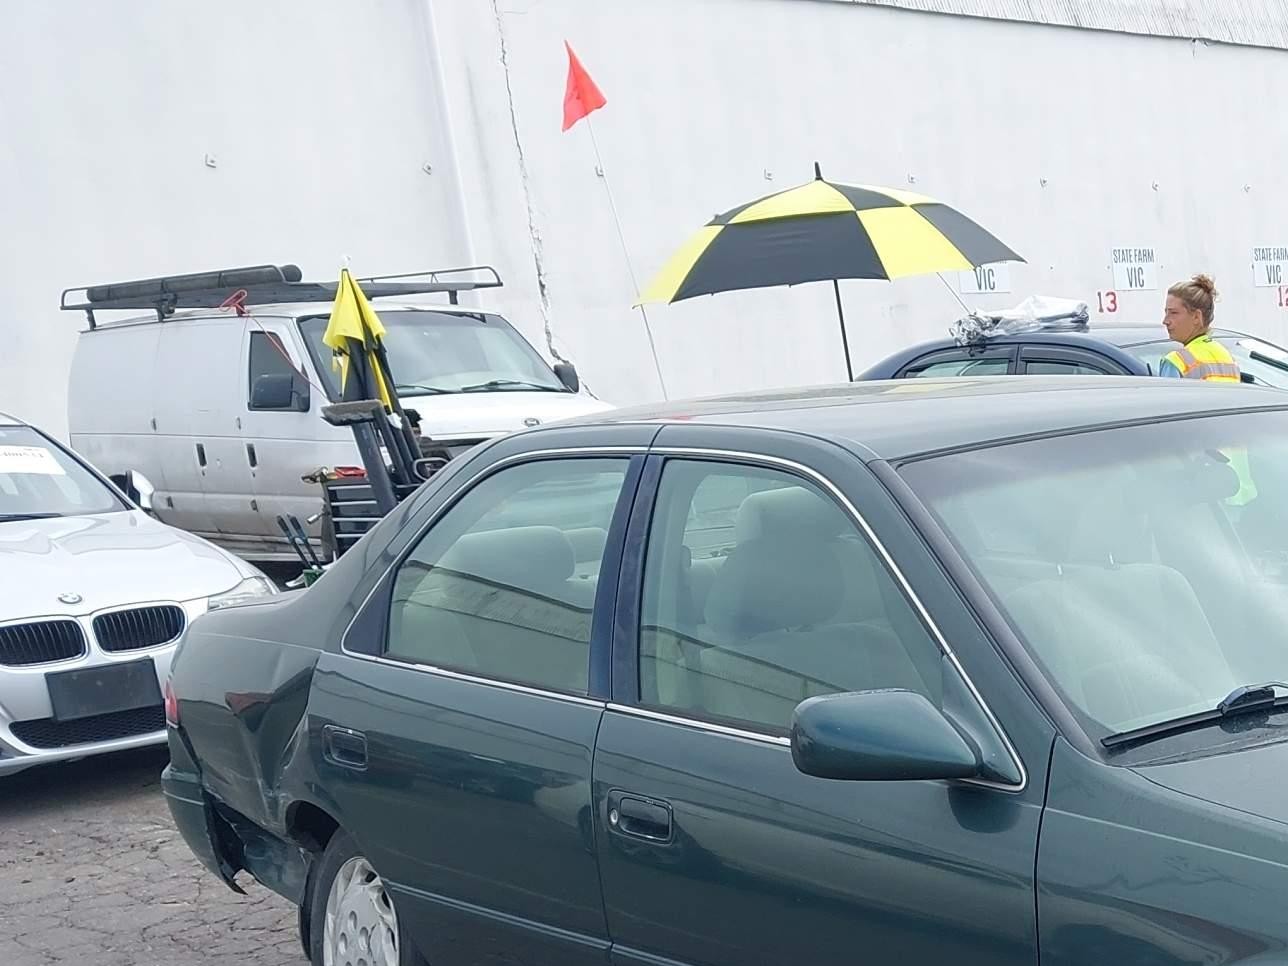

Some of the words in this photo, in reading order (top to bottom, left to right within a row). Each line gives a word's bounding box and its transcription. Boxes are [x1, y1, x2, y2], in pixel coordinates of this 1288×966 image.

[1113, 248, 1134, 263] STATE
[1134, 248, 1155, 263] FARM
[1254, 248, 1272, 262] STATE
[975, 268, 996, 291] VIC
[1126, 266, 1145, 288] VIC
[1266, 264, 1282, 284] VIC
[1097, 291, 1118, 313] 13
